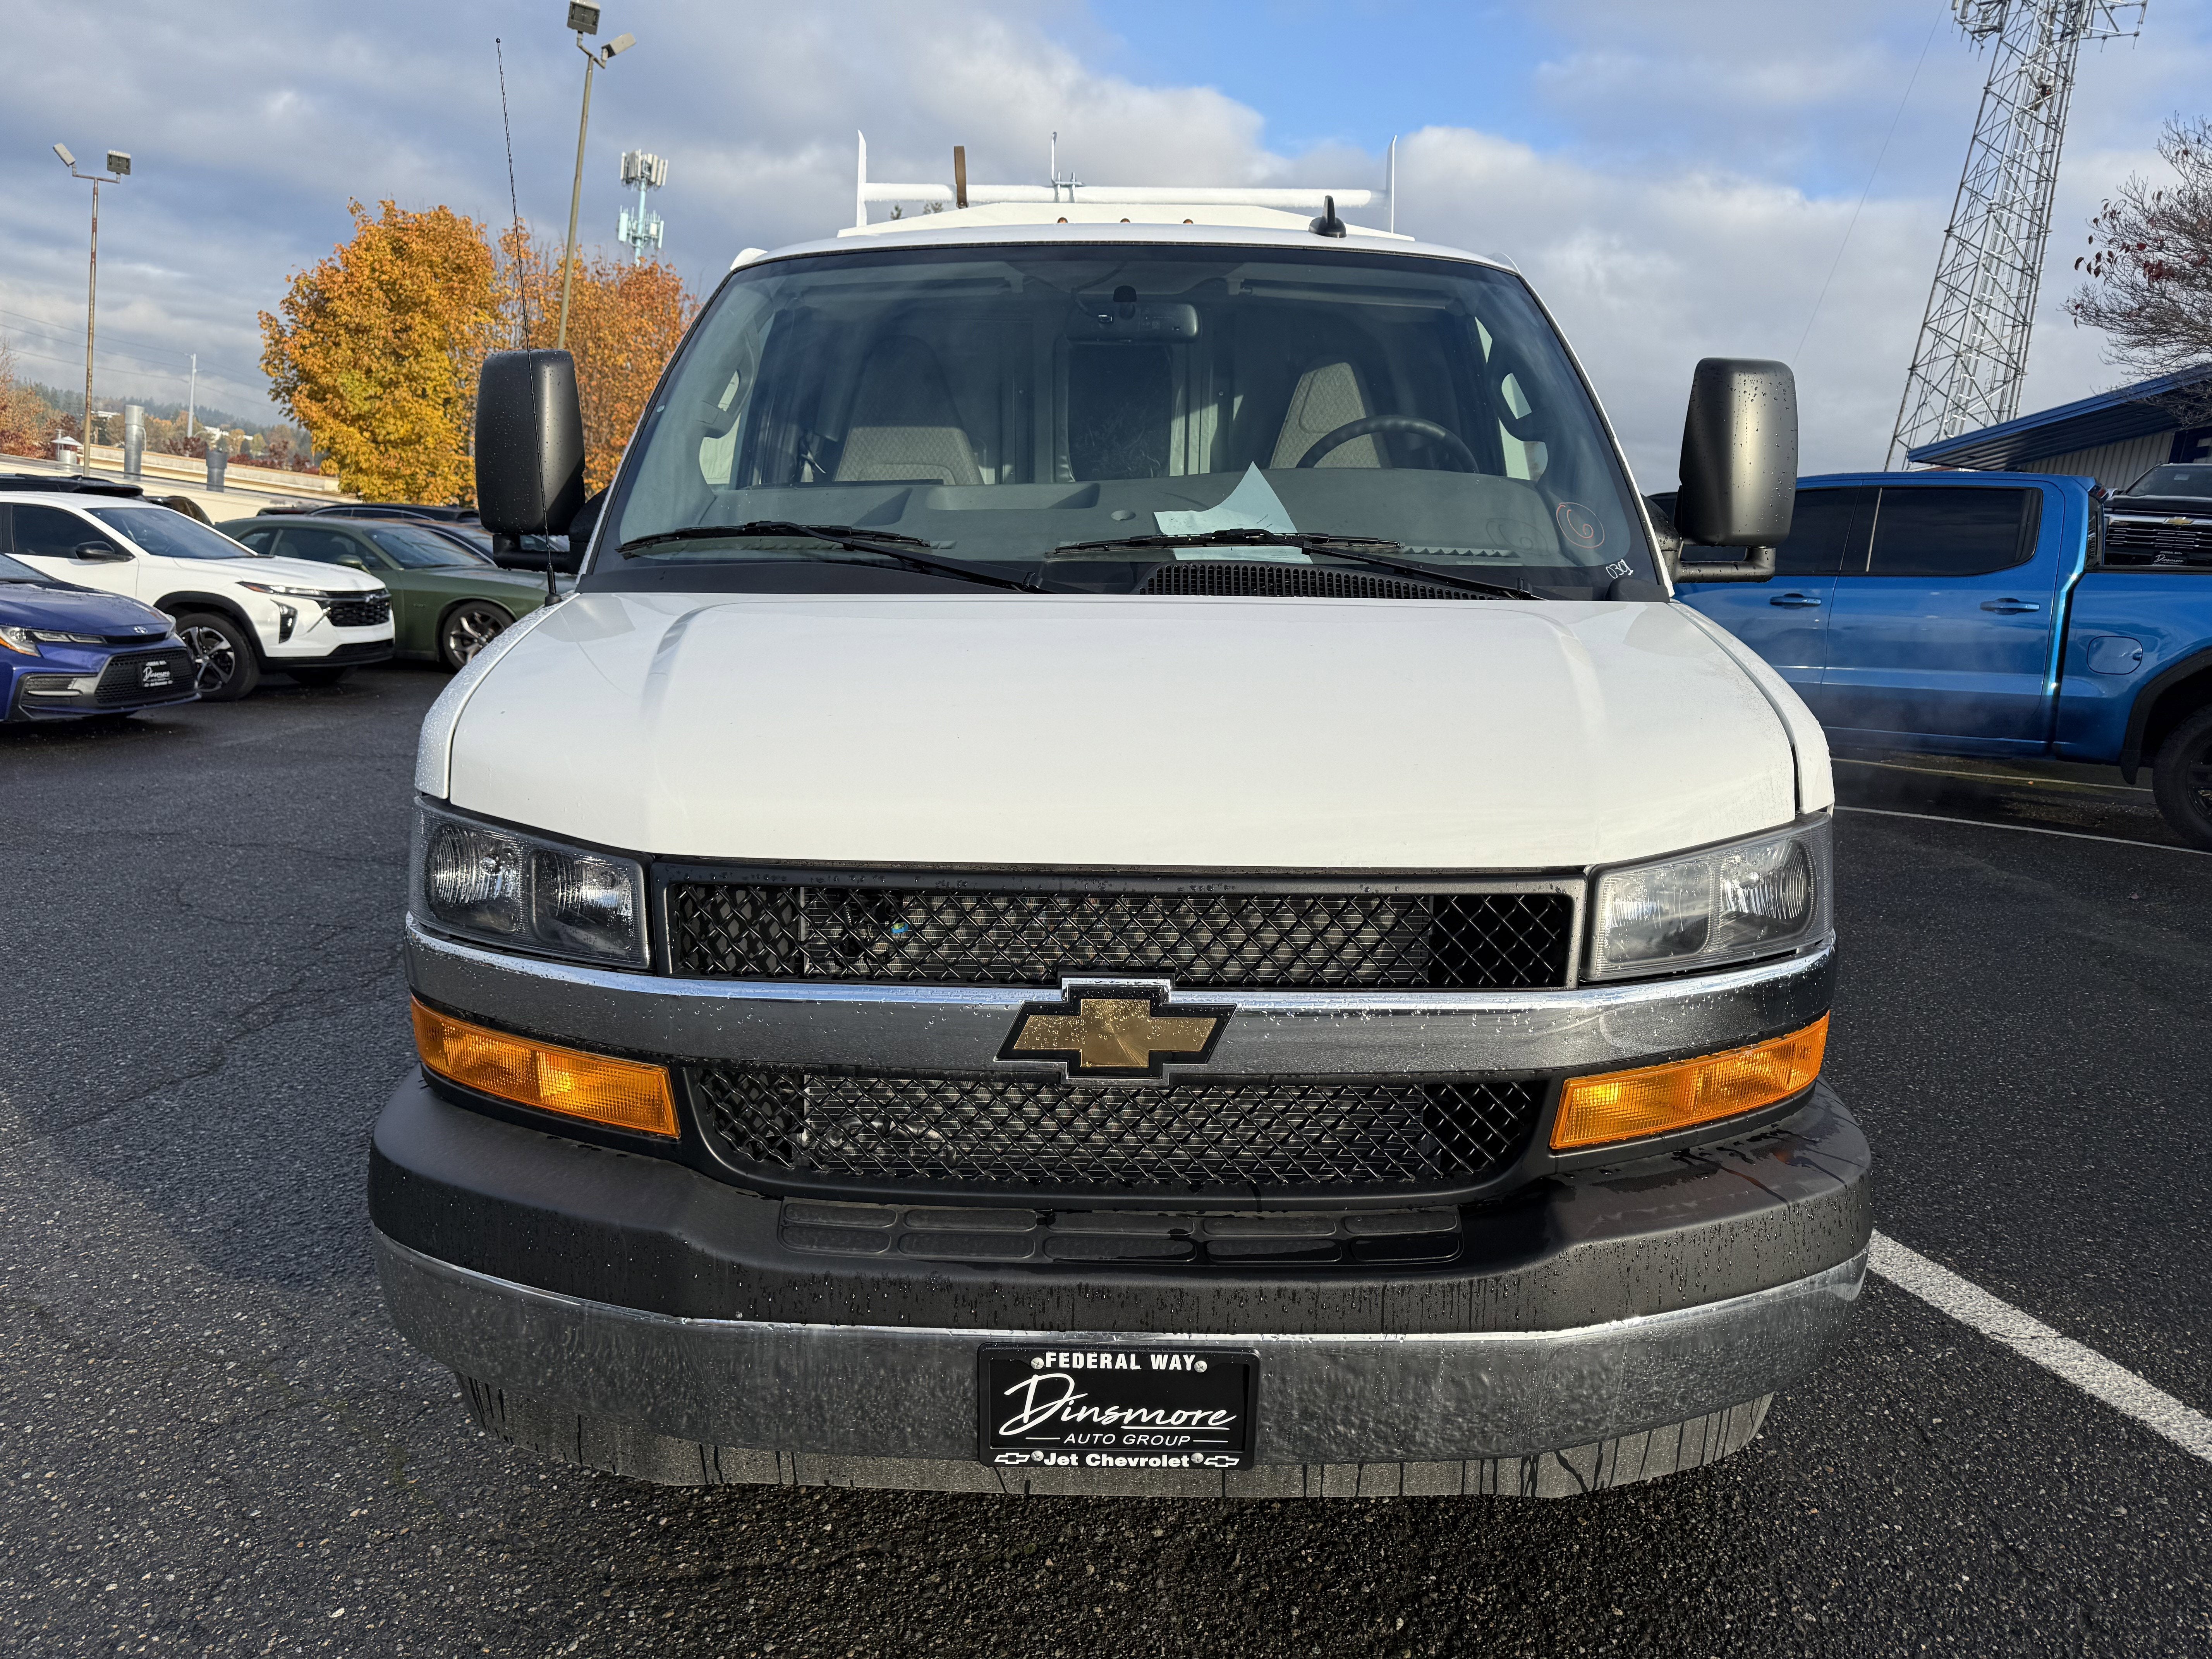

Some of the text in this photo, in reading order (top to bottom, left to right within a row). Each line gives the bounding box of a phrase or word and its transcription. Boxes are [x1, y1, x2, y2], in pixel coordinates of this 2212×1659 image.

[1046, 1352, 1195, 1371] FEDERAL WAY
[999, 1373, 1237, 1436] Dinsmore
[1063, 1433, 1190, 1446] AUTO GROUP
[1044, 1453, 1190, 1467] Jet Chevrolet
